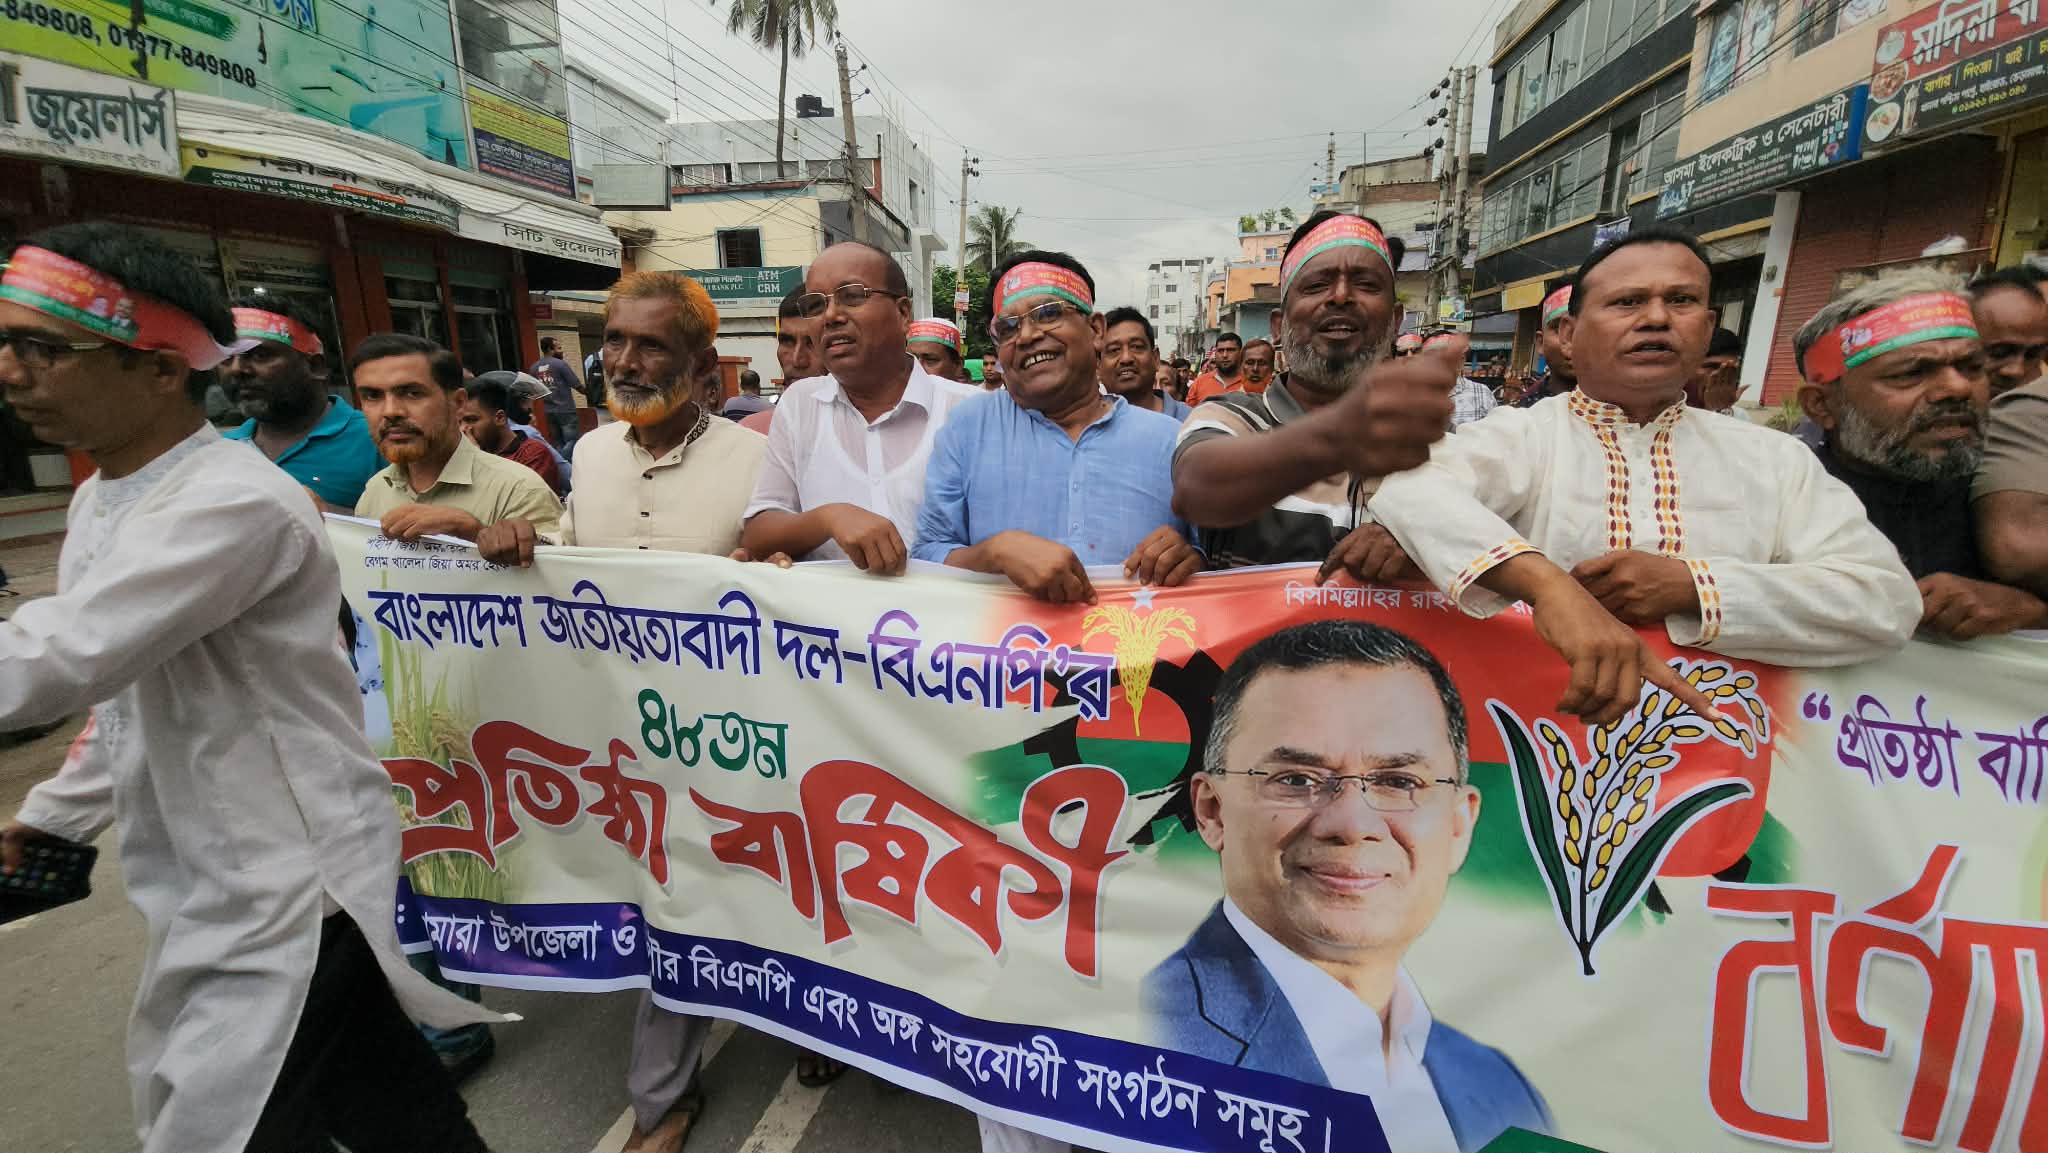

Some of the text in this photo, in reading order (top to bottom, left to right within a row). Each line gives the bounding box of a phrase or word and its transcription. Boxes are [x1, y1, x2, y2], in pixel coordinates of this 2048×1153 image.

[1911, 0, 1998, 65] মদিনা
[24, 85, 169, 152] জুয়েলার্স
[1663, 159, 1697, 185] আসমা
[1762, 129, 1773, 147] ও
[1778, 93, 1848, 143] সেনেটারী
[503, 222, 544, 243] সিটি
[551, 237, 619, 260] জুয়েলার্স
[757, 270, 779, 281] ATM
[757, 283, 780, 293] CRM
[365, 555, 388, 569] বেগম
[392, 556, 425, 570] খালেদা
[429, 554, 452, 570] জিয়া
[456, 559, 481, 572] অমর
[367, 589, 528, 650] বাংলাদেশ
[533, 579, 762, 675] জাতীয়তাবাদী
[637, 688, 788, 781] ৪৮তম
[378, 720, 1130, 979] প্রতিষ্ঠা বার্ষিকী
[490, 908, 603, 962] উপজেলা
[611, 923, 637, 957] ও
[687, 945, 796, 1011] বিএনপি
[803, 983, 861, 1039] এবং
[867, 995, 924, 1055] অঙ্গ
[928, 1033, 1068, 1101] সহযোগী
[1074, 1054, 1206, 1129] সংগঠন
